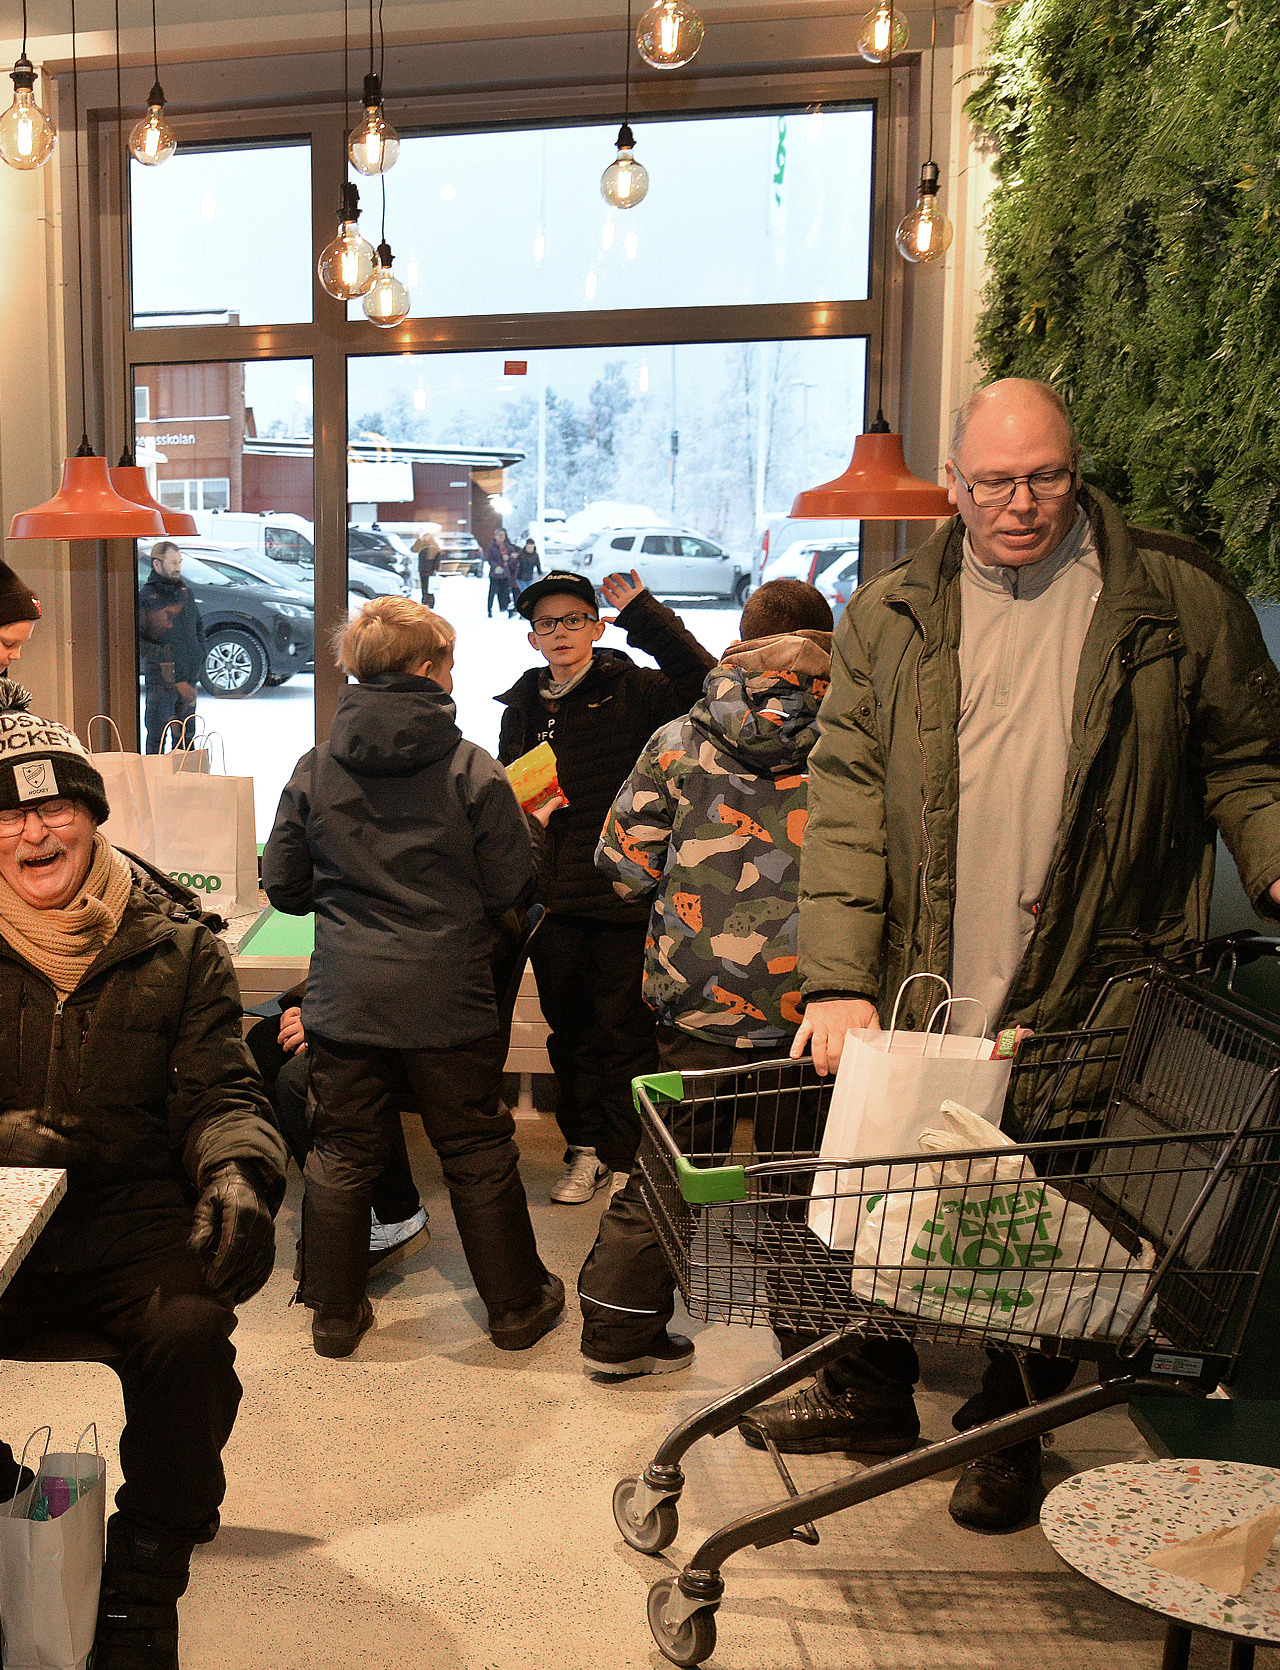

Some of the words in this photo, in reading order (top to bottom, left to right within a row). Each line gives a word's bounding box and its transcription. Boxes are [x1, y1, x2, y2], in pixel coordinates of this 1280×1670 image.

[136, 433, 196, 446] esskolan
[28, 787, 50, 796] HOCKEY
[938, 1188, 1049, 1219] MMEN
[911, 1284, 1034, 1313] op
